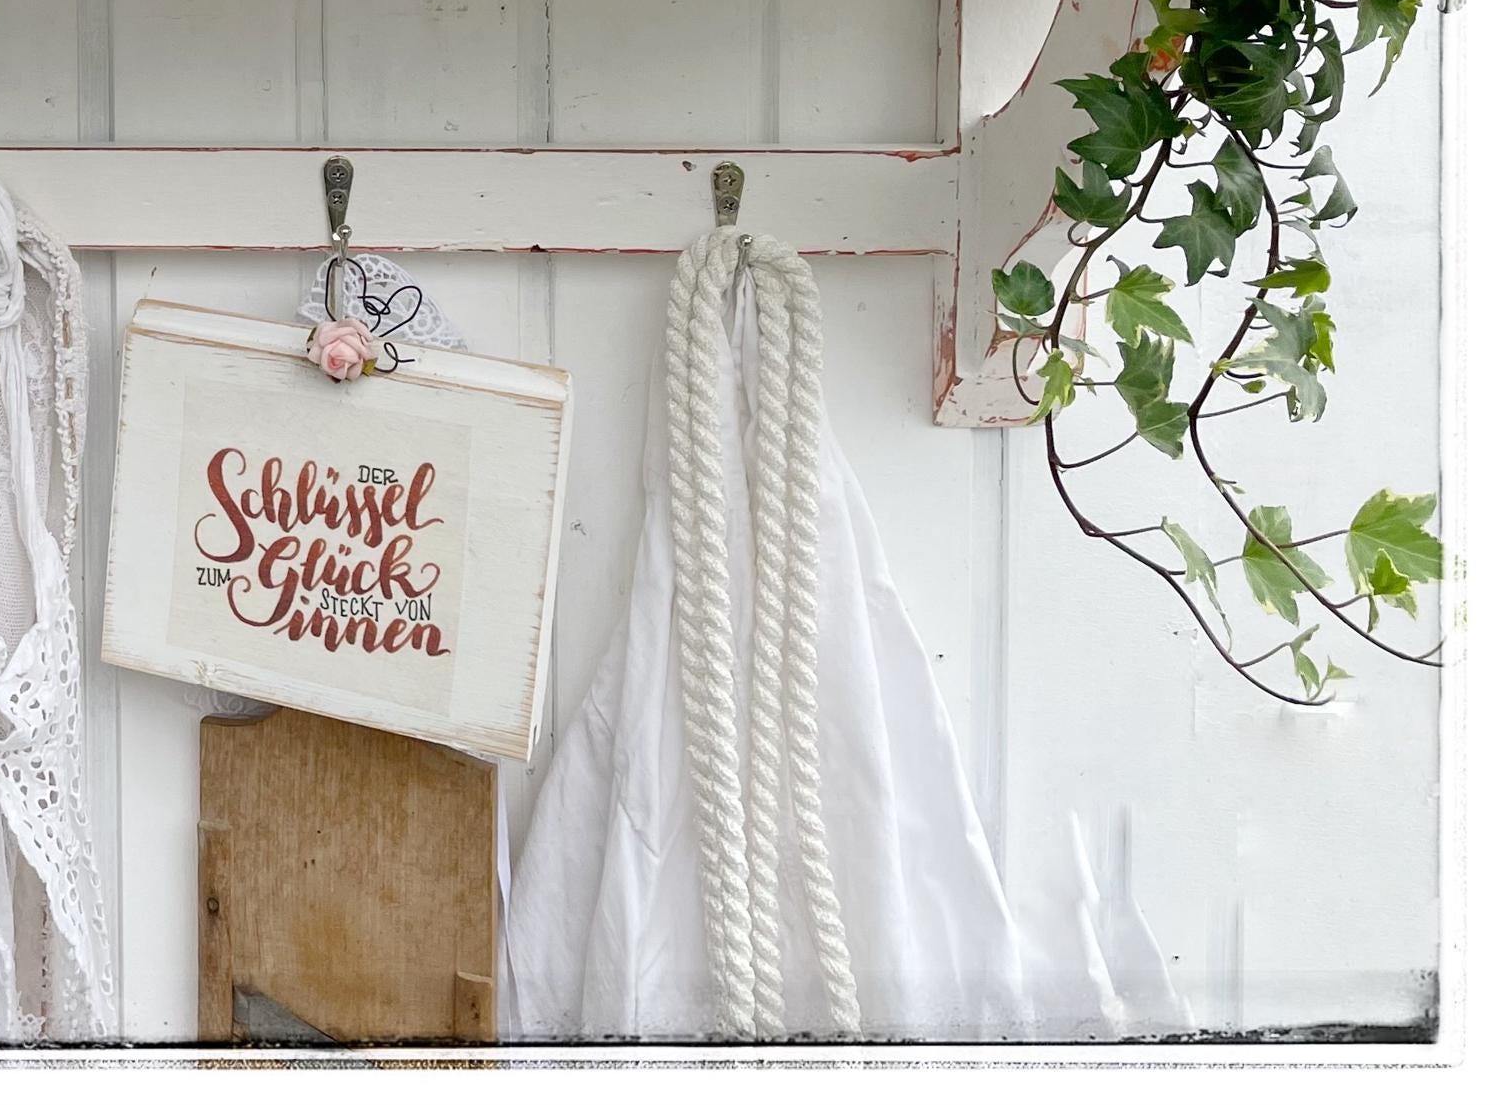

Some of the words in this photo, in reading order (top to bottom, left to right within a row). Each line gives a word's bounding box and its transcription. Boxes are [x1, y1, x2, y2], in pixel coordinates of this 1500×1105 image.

[195, 448, 444, 563] Schlüssel
[357, 465, 398, 485] DER
[196, 567, 231, 587] ZUM
[227, 534, 440, 627] Glück
[320, 588, 383, 622] STECKT
[395, 593, 432, 621] VON
[273, 595, 451, 656] innen
